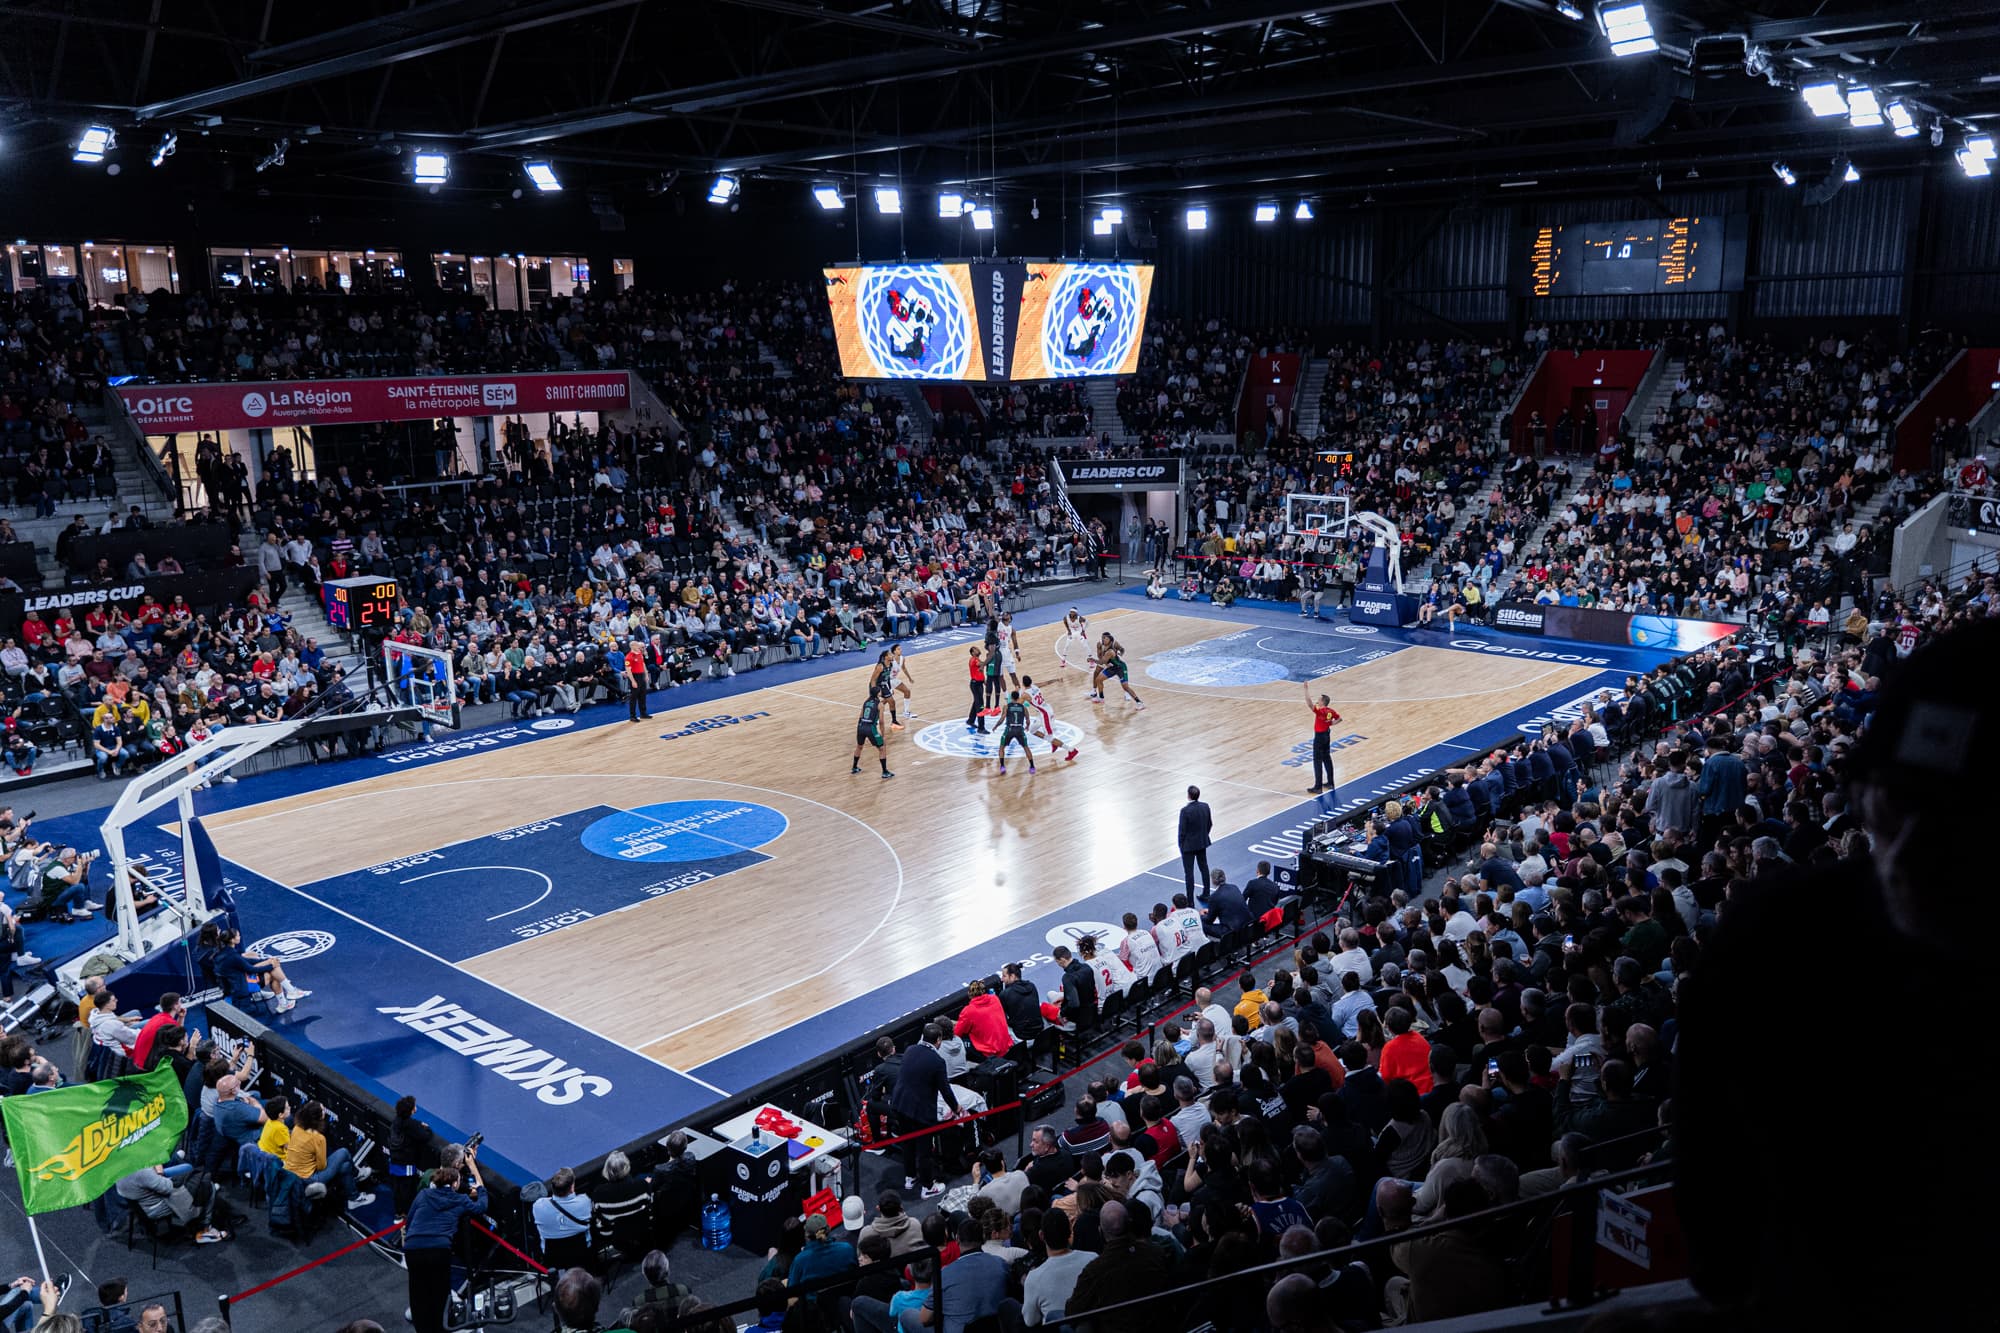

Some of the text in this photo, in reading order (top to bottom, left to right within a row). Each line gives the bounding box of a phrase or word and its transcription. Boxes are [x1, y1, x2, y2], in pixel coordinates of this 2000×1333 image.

[991, 270, 1005, 377] LEADERS CUP
[1272, 360, 1280, 372] K
[1596, 359, 1604, 372] J
[270, 387, 352, 406] La Région
[387, 383, 479, 399] SAINT-ÉTIENNE
[486, 385, 514, 402] SÉM
[272, 405, 353, 418] Auvergne-Rhône-Alpes
[405, 397, 480, 411] la métropole
[137, 415, 194, 424] DÉPARTEMENT
[1071, 465, 1166, 480] LEADERS CUP
[24, 585, 145, 613] LEADERS CUP
[1355, 600, 1392, 611] LEADERS
[330, 601, 346, 623] 24
[361, 600, 390, 624] 24
[1363, 607, 1381, 615] CUP
[1497, 608, 1543, 622] SiliGom
[659, 712, 771, 741] LEADERS
[684, 715, 733, 729] CUP
[386, 729, 538, 765] La Région
[1101, 968, 1113, 986] 2
[376, 994, 614, 1106] SKWEEK
[103, 1113, 117, 1128] LES
[80, 1092, 166, 1168] DUNKERS
[731, 1185, 759, 1202] LEADERS
[761, 1180, 789, 1202] LEADERS
